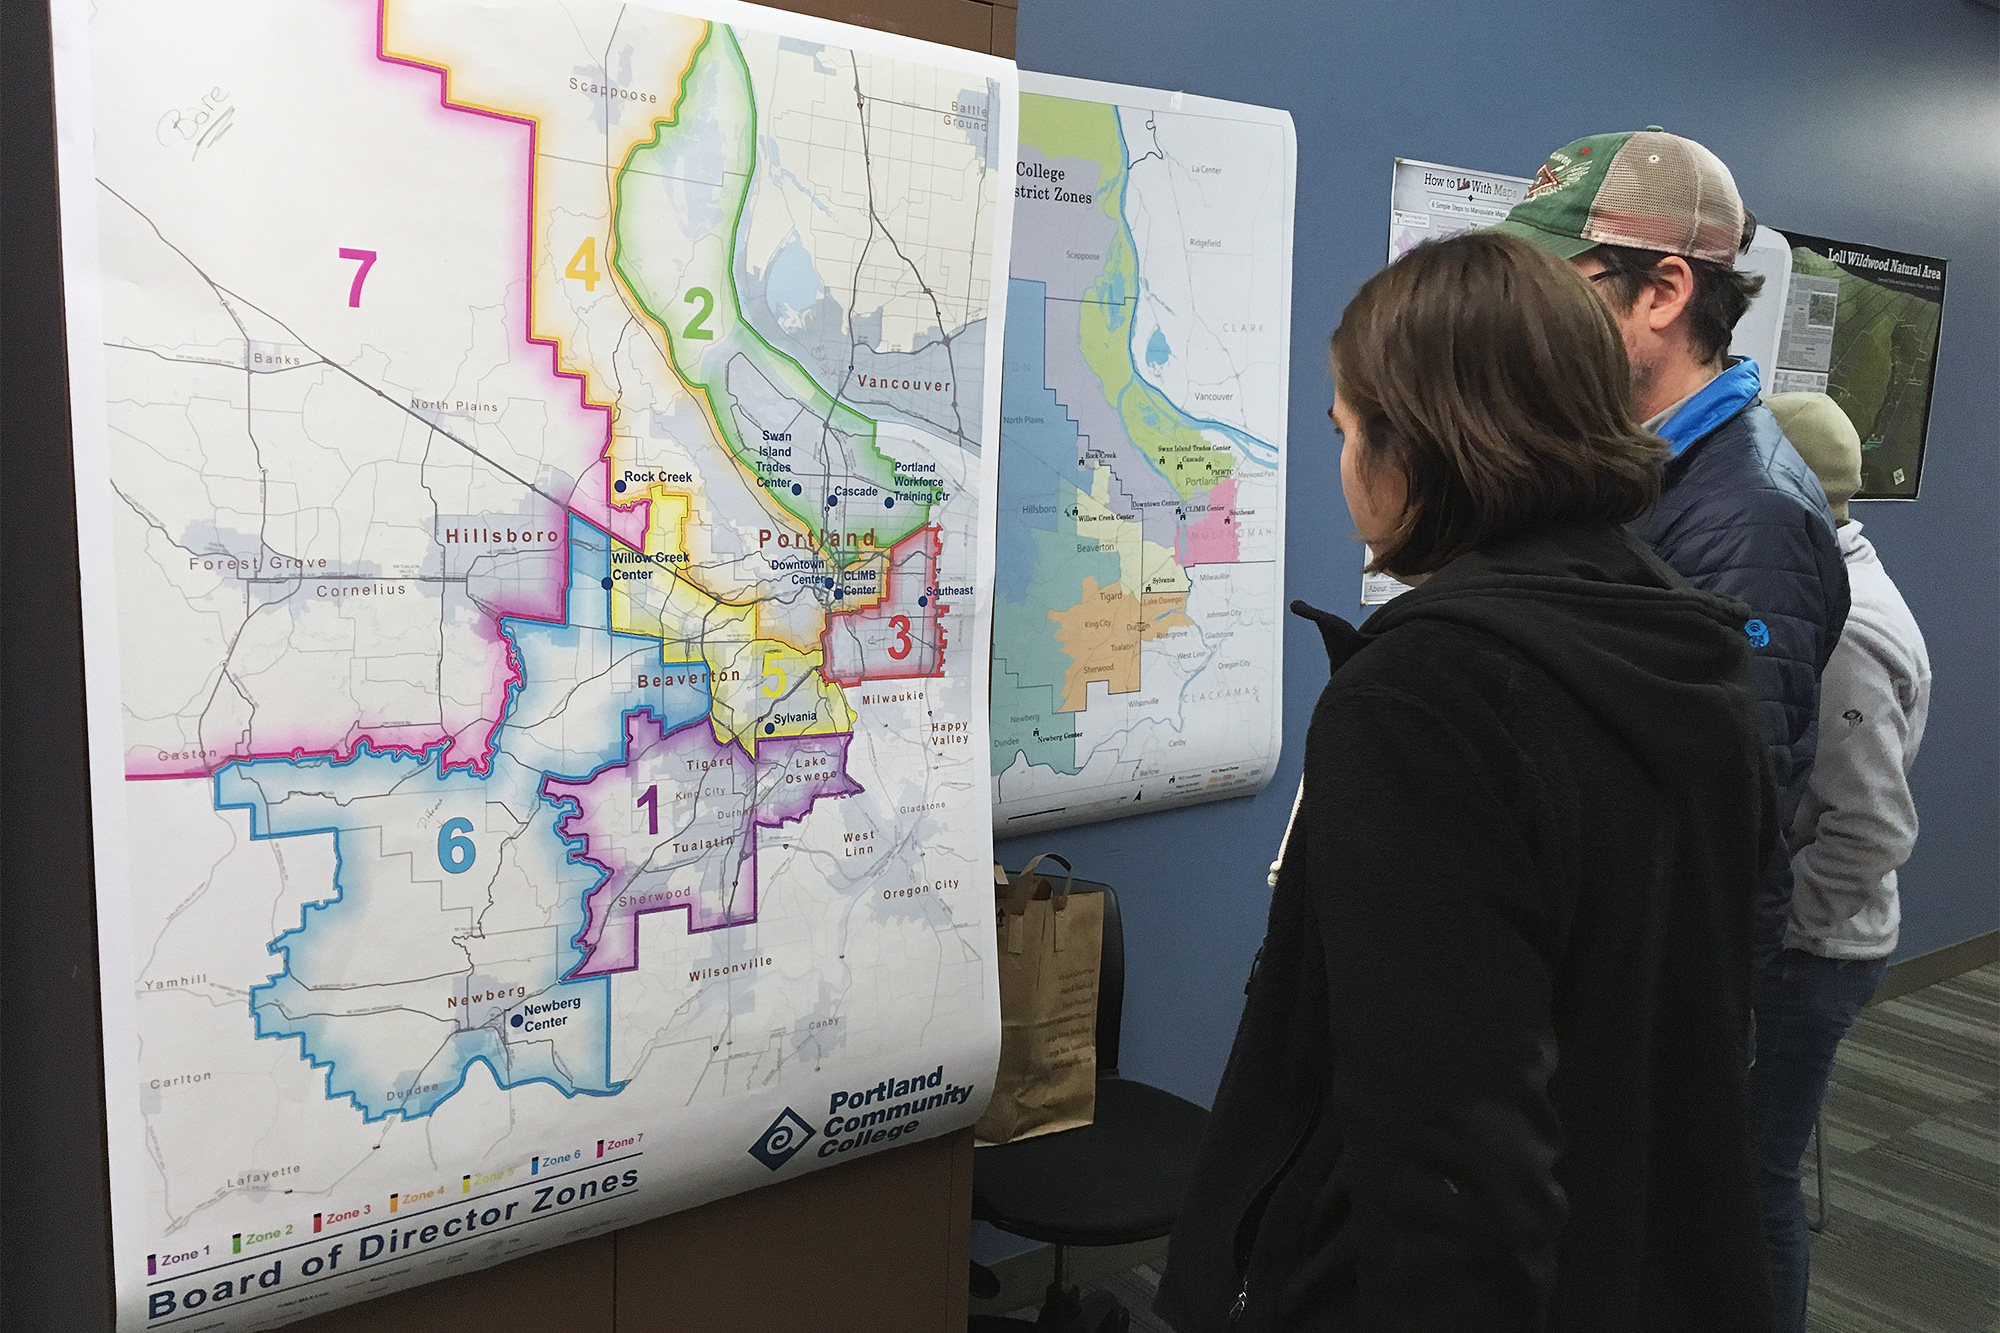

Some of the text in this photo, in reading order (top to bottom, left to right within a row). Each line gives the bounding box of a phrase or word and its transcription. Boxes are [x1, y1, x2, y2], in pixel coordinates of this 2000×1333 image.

[569, 77, 657, 103] Scappoose
[951, 101, 987, 118] Battle
[943, 115, 987, 132] Ground
[1016, 161, 1066, 182] College
[1191, 165, 1222, 175] La Center
[1424, 173, 1445, 187] How
[1446, 179, 1455, 189] to
[1471, 180, 1492, 195] With
[1493, 183, 1517, 201] Maps
[1054, 187, 1092, 204] Zones
[1435, 202, 1450, 211] Simple
[1451, 204, 1464, 213] Steps
[1470, 206, 1494, 217] Manipulate
[1495, 209, 1507, 218] Maps
[1190, 239, 1221, 249] Ridgefield
[1066, 251, 1100, 262] Scappoose
[565, 236, 601, 292] 4
[1828, 248, 1941, 280] Loll Wildwood Natural Area
[338, 247, 377, 308] 7
[682, 286, 714, 341] 2
[1223, 323, 1264, 333] CLARK
[254, 353, 300, 366] Banks
[858, 374, 951, 392] Vancouver
[1195, 392, 1233, 401] Vancouver
[411, 399, 498, 412] North Plains
[1003, 416, 1023, 424] North
[762, 430, 792, 442] Swan
[759, 446, 792, 457] Island
[756, 462, 791, 473] Trades
[894, 462, 936, 473] Portland
[624, 470, 693, 483] Rock Creek
[894, 476, 944, 487] Workforce
[1186, 477, 1219, 486] Portland
[1238, 471, 1263, 479] Maywood
[756, 477, 791, 488] Center
[834, 486, 878, 497] Cascade
[894, 490, 950, 503] Training Ctr
[1022, 505, 1057, 514] Hillsboro
[446, 528, 559, 544] Hillsboro
[759, 528, 876, 549] Portland
[1076, 543, 1115, 553] Beaverton
[189, 556, 327, 571] Forest Grove
[612, 552, 690, 564] Willow Creek
[771, 560, 825, 571] Downtown
[612, 569, 653, 580] Center
[791, 574, 825, 585] Center
[844, 570, 876, 581] CLIMB
[1152, 577, 1175, 586] Sylvania
[1200, 573, 1230, 581] Milwaukie
[316, 584, 406, 598] Cornelius
[844, 585, 876, 596] Center
[926, 586, 973, 597] Southeast
[1368, 585, 1387, 593] About
[1100, 591, 1123, 602] Tigard
[1143, 596, 1182, 606] Lake Oswego
[1206, 609, 1242, 619] Johnson City
[1085, 619, 1112, 630] King City
[887, 614, 912, 660] 3
[1156, 630, 1188, 640] Rivergrove
[1205, 630, 1234, 640] Gladstone
[1111, 644, 1135, 652] Tualatin
[1177, 651, 1206, 660] West Linn
[1083, 664, 1115, 674] Sherwood
[1217, 660, 1251, 671] Oregon City
[637, 669, 740, 688] Beaverton
[760, 651, 787, 699] 5
[862, 691, 924, 705] Milwaukie
[1183, 687, 1258, 703] CLACKAMAS
[1128, 697, 1159, 709] Wilsonville
[774, 711, 817, 725] Sylvania
[1010, 713, 1040, 725] Newberg
[931, 721, 968, 733] Happy
[932, 734, 969, 746] Valley
[994, 737, 1020, 747] Dundee
[1037, 730, 1083, 745] Newberg Center
[1168, 738, 1186, 749] Canby
[157, 748, 217, 762] Gaston
[687, 755, 733, 771] Tigard
[795, 757, 827, 768] Lake
[785, 770, 837, 784] Oswego
[675, 787, 726, 803] King City
[637, 784, 658, 836] 1
[717, 807, 757, 820] Durham
[899, 801, 946, 815] Gladstone
[843, 830, 875, 843] West
[437, 816, 476, 875] 6
[673, 836, 734, 854] Tualatin
[845, 845, 873, 857] Linn
[883, 878, 960, 900] Oregon City
[619, 886, 691, 907] Sherwood
[689, 956, 773, 982] Wilsonville
[144, 973, 207, 990] Yamhill
[447, 985, 525, 1008] Newberg
[524, 996, 581, 1016] Newberg
[524, 1014, 568, 1033] Center
[808, 1016, 839, 1031] Canby
[150, 1071, 212, 1090] Carlton
[386, 1082, 439, 1101] Dundee
[829, 1065, 944, 1115] Portland
[823, 1084, 974, 1138] Community
[607, 1133, 644, 1151] Zone 7
[817, 1119, 919, 1159] College
[542, 1149, 581, 1168] Zone 6
[227, 1165, 301, 1189] Lafayette
[402, 1185, 445, 1205] Zone 4
[326, 1204, 371, 1225] Zone 3
[246, 1224, 293, 1245] Zone 2
[148, 1168, 639, 1320] Board of Director Zones
[161, 1244, 211, 1266] Zone 1
